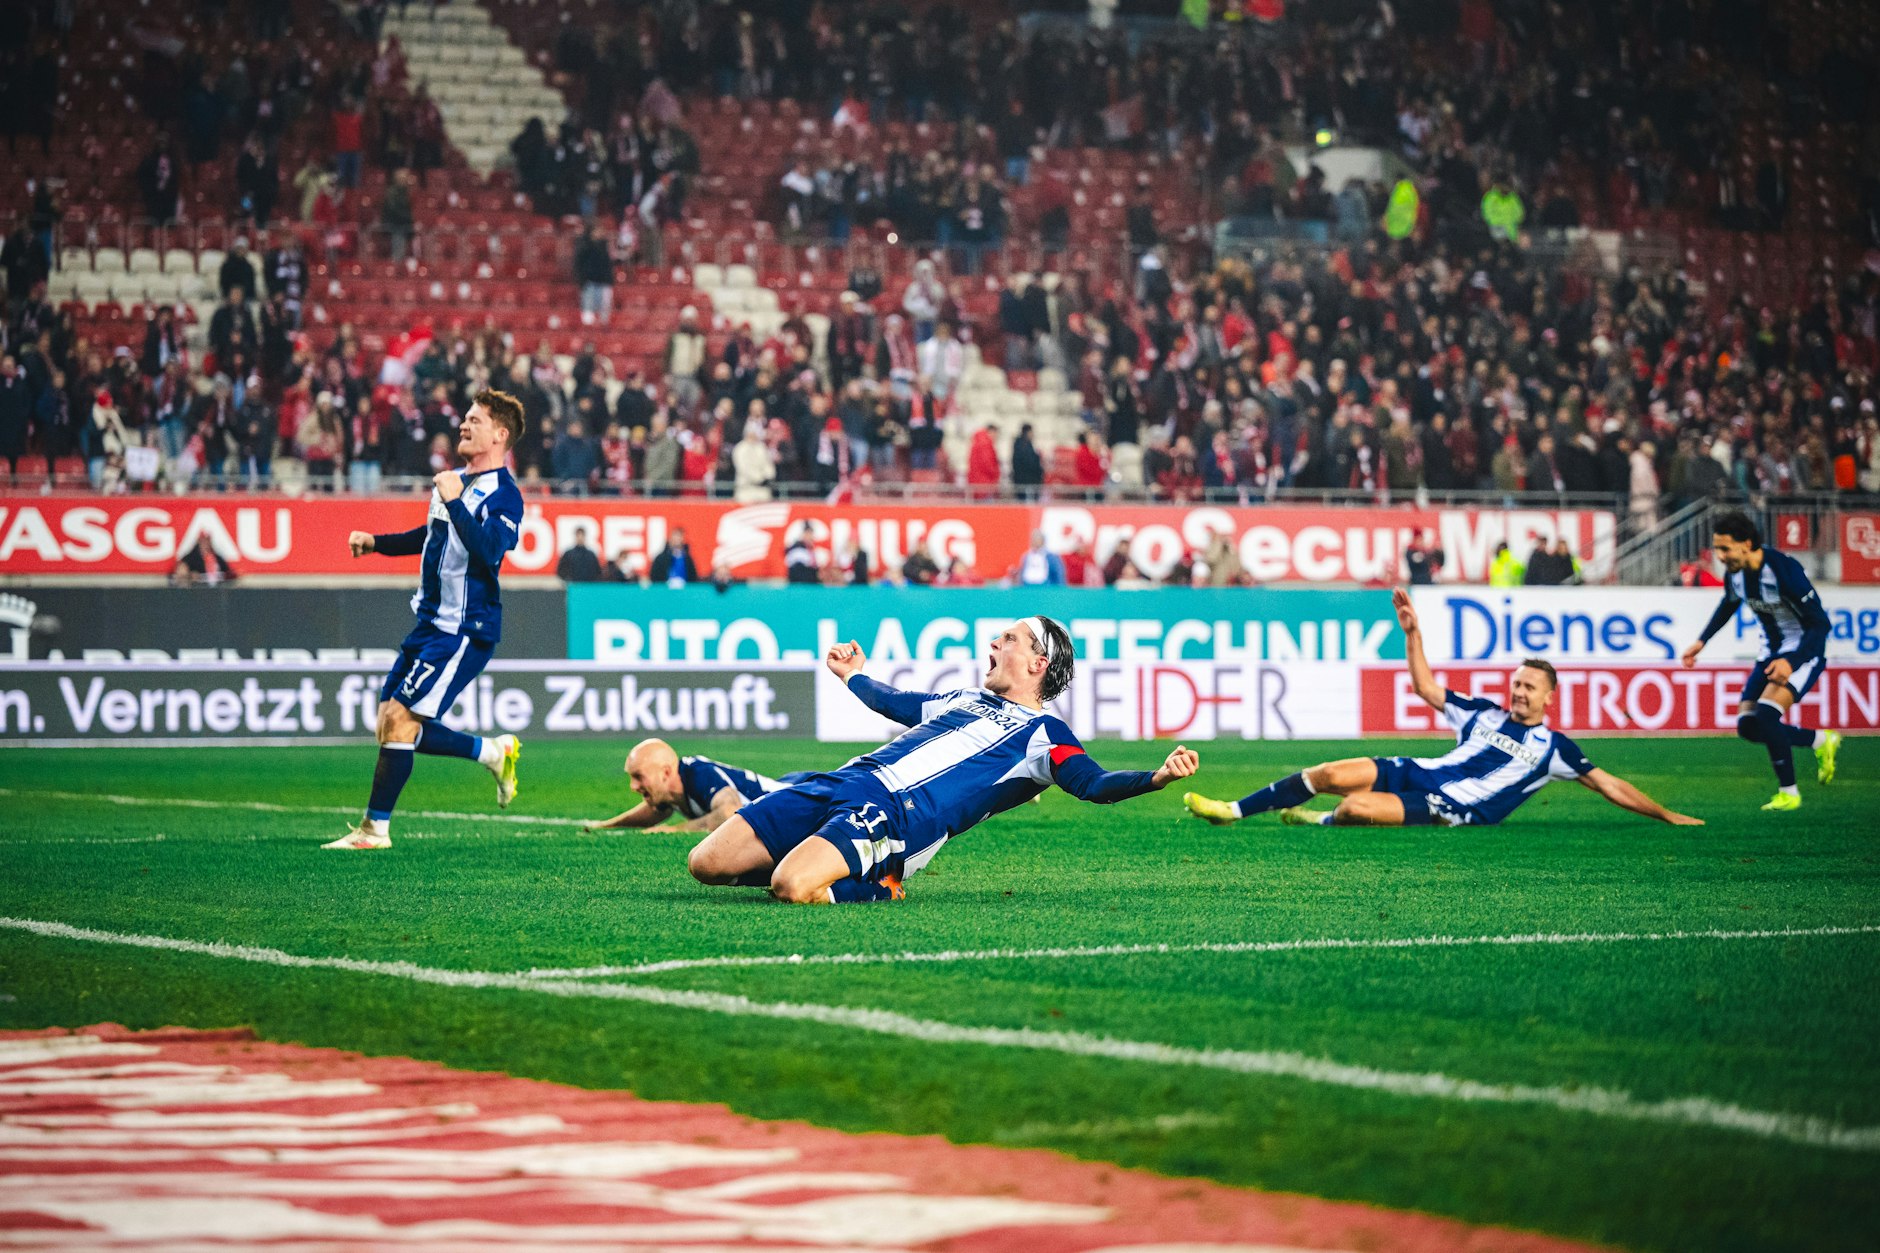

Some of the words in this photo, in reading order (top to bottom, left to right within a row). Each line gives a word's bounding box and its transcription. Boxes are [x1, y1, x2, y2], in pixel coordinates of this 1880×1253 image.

[0, 506, 292, 562] ASGAU
[593, 617, 1393, 660] BITO-LAGETECHNIK
[1446, 597, 1677, 659] Dienes
[405, 659, 435, 690] 17
[1394, 670, 1880, 729] ELETROTEHN
[58, 676, 325, 733] Vernetzt
[336, 674, 389, 732] fü
[440, 675, 534, 732] die
[544, 674, 790, 732] Zukunft.
